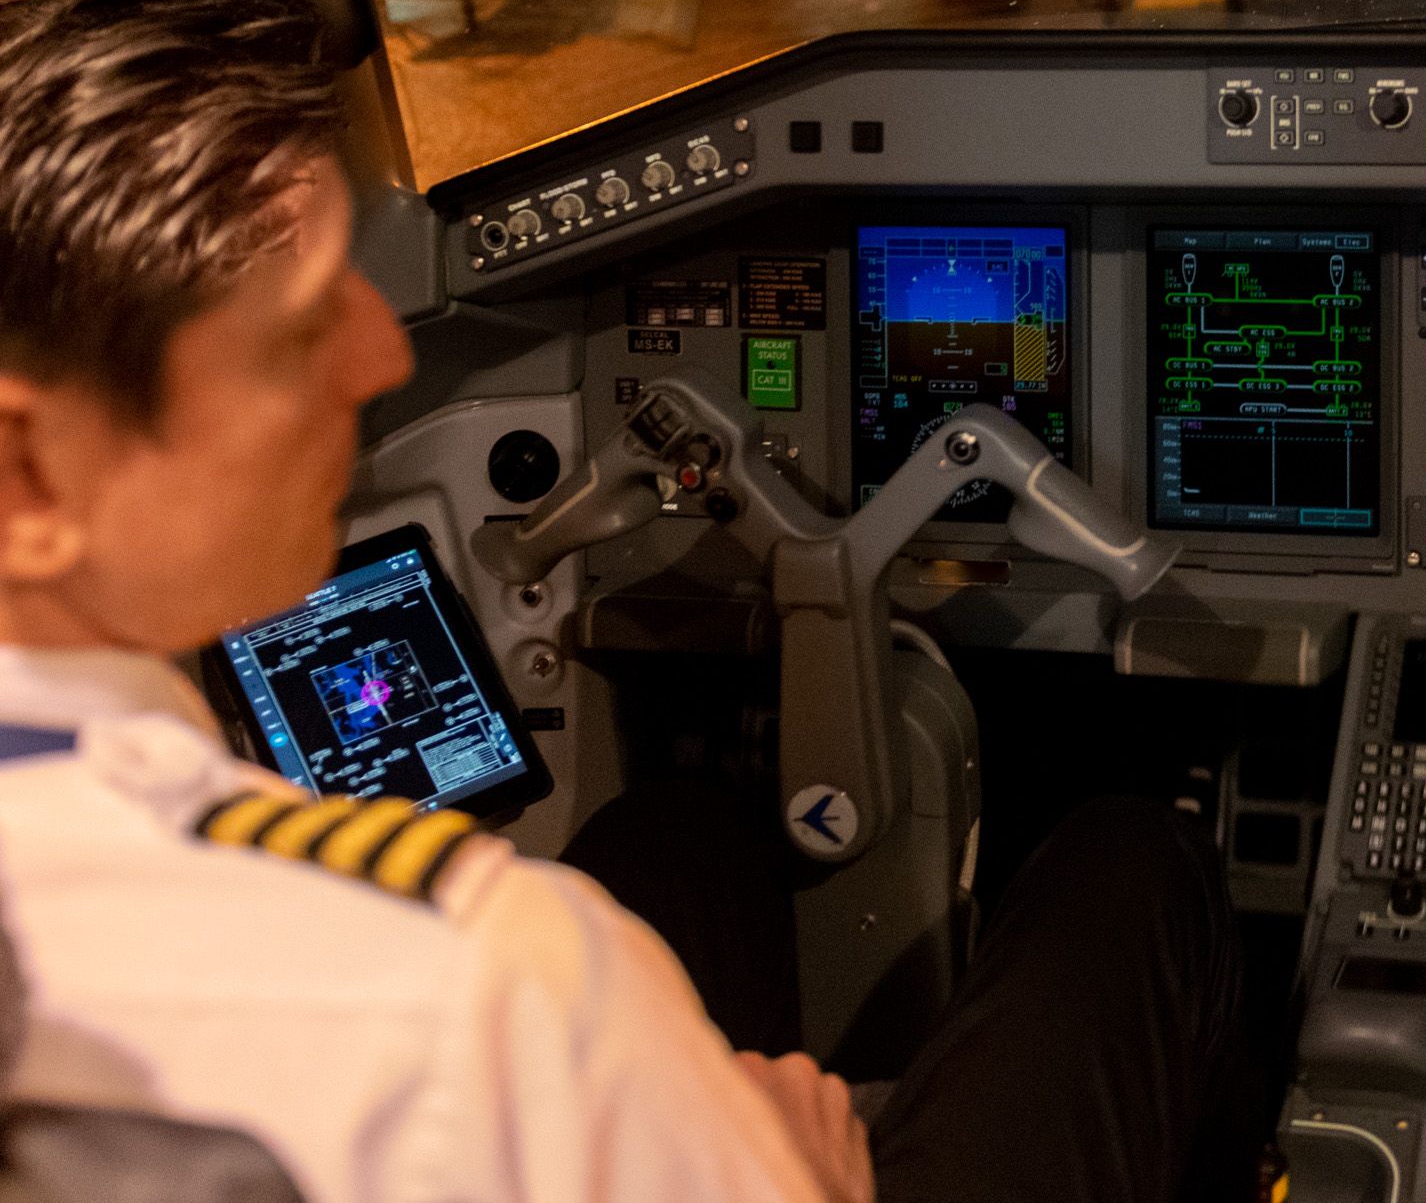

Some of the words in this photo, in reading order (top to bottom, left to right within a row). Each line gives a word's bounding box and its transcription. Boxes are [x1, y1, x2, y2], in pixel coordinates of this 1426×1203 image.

[633, 339, 674, 351] MS-EK
[752, 340, 791, 350] AIRCRAFT
[758, 351, 788, 360] STATUS
[757, 375, 774, 386] CAT
[777, 375, 788, 386] III
